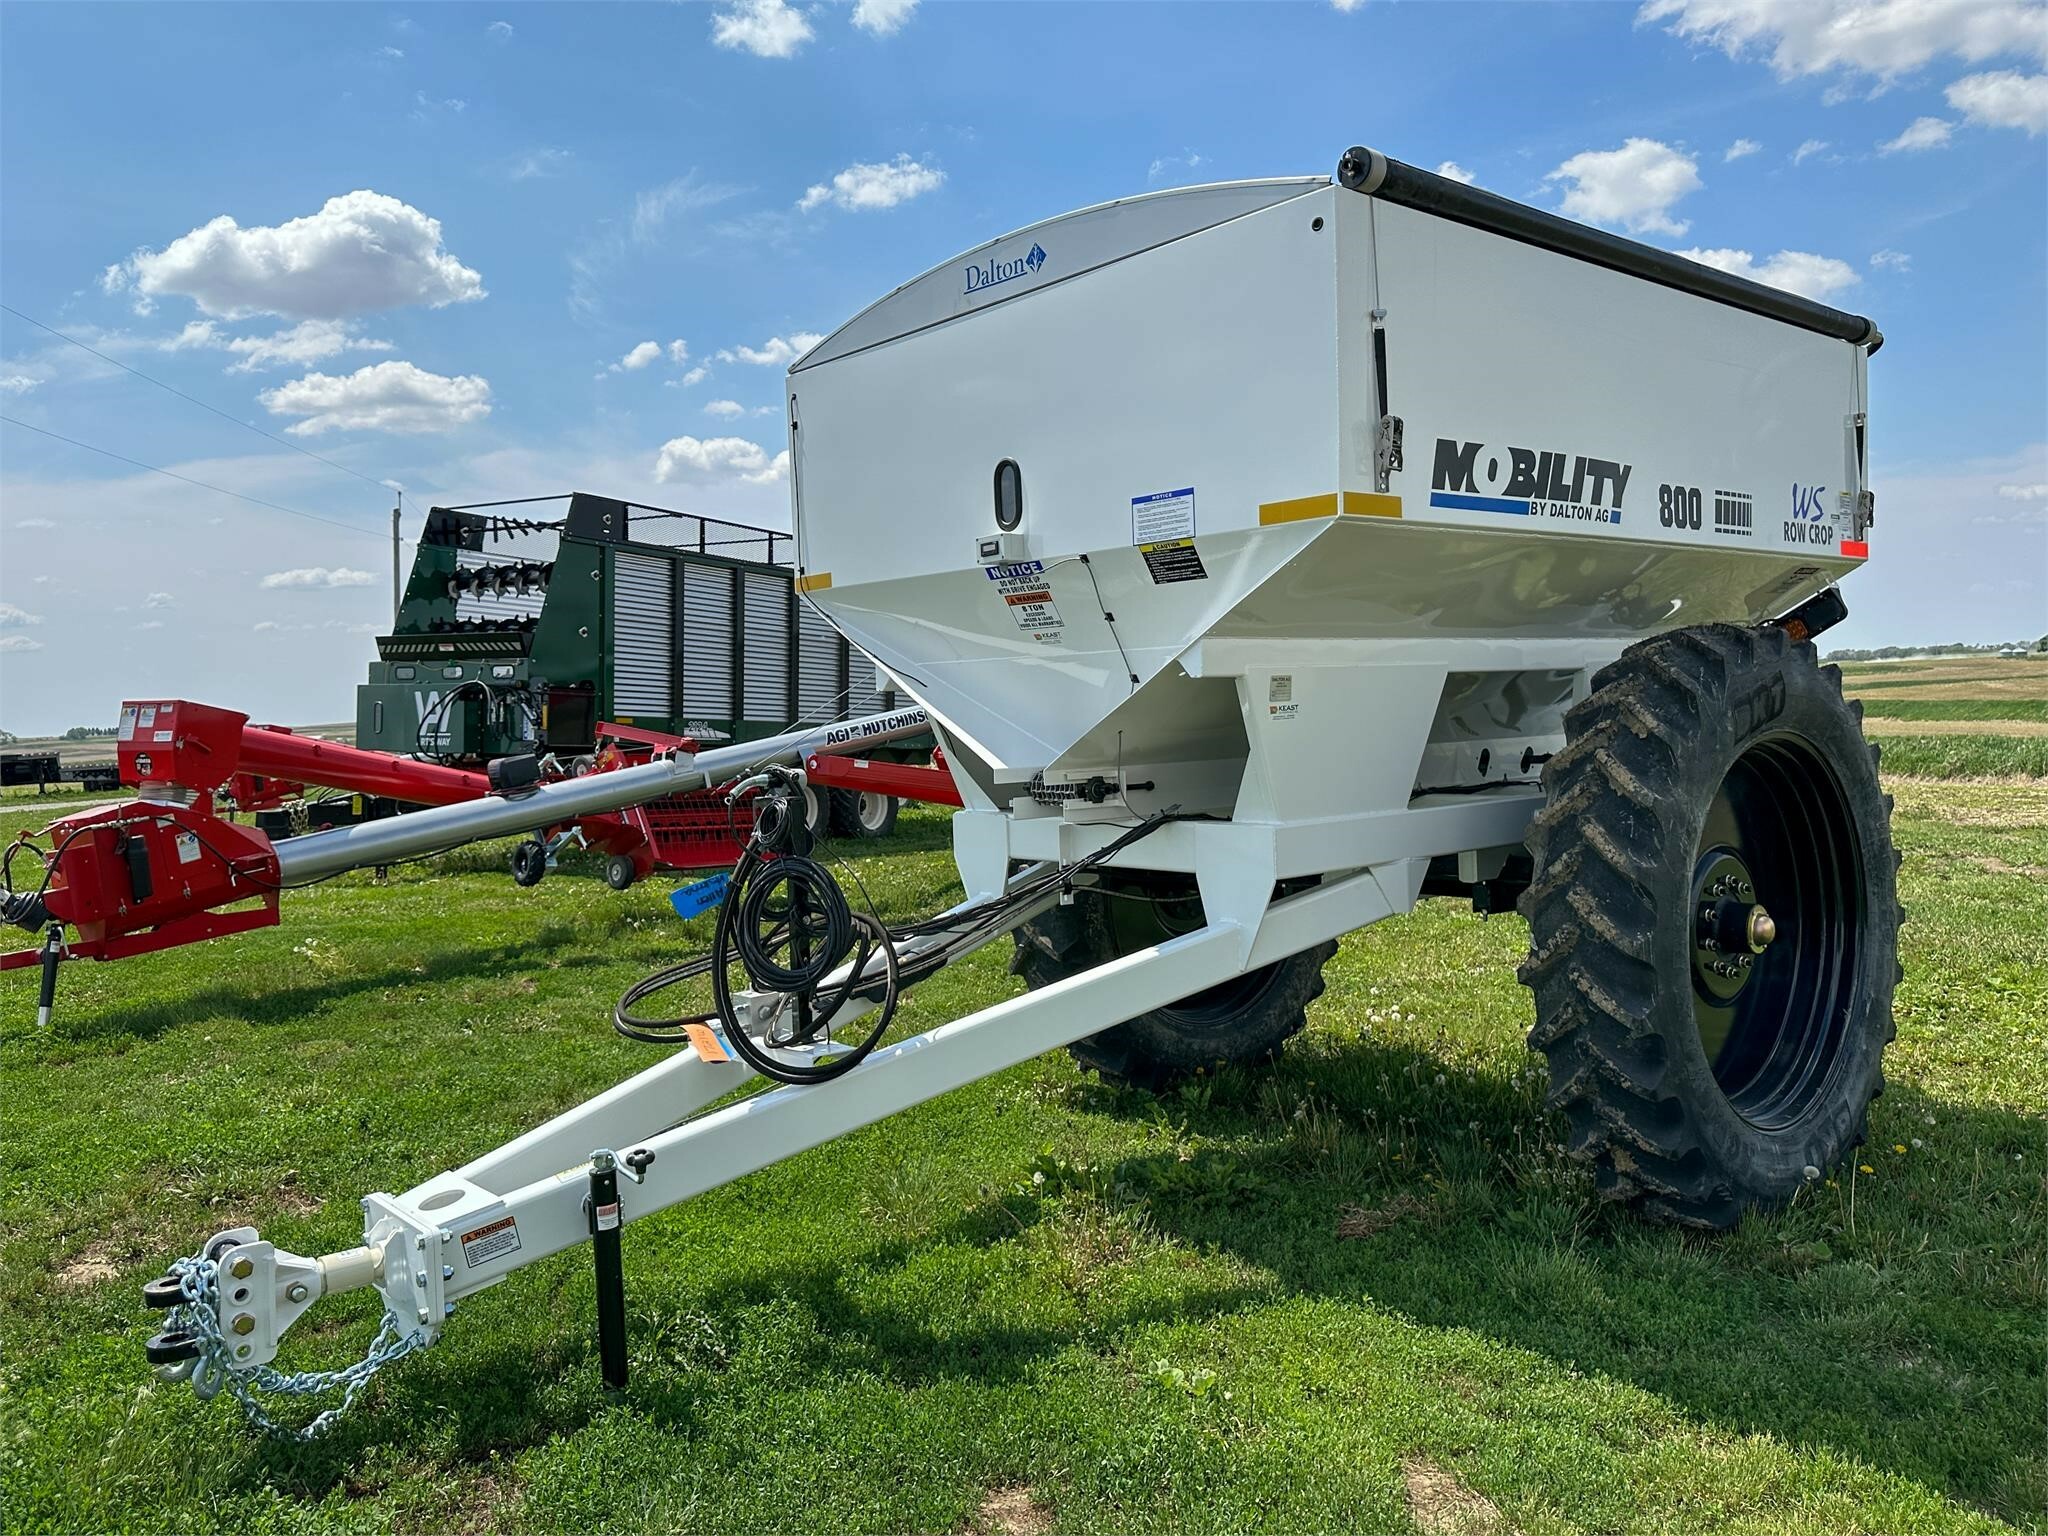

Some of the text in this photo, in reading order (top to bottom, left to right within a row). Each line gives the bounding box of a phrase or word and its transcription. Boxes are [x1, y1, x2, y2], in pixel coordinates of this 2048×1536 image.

[964, 257, 1025, 291] Dalton
[1431, 438, 1633, 509] MOBILITY
[1530, 501, 1609, 523] BY DALTON AG
[1658, 483, 1702, 530] 800
[1792, 482, 1826, 522] WS
[1783, 521, 1833, 545] ROW CROP
[1156, 541, 1181, 550] CAUTION
[1000, 580, 1008, 588] DO
[1008, 578, 1018, 587] NOT
[1018, 577, 1034, 585] BACK
[1011, 586, 1026, 594] DRIVE
[1026, 583, 1051, 591] ENGAGED
[1015, 593, 1049, 602] WARNING
[1028, 603, 1045, 612] TON
[826, 710, 929, 746] AGI HUTCHINS
[473, 1219, 512, 1238] WARNING
